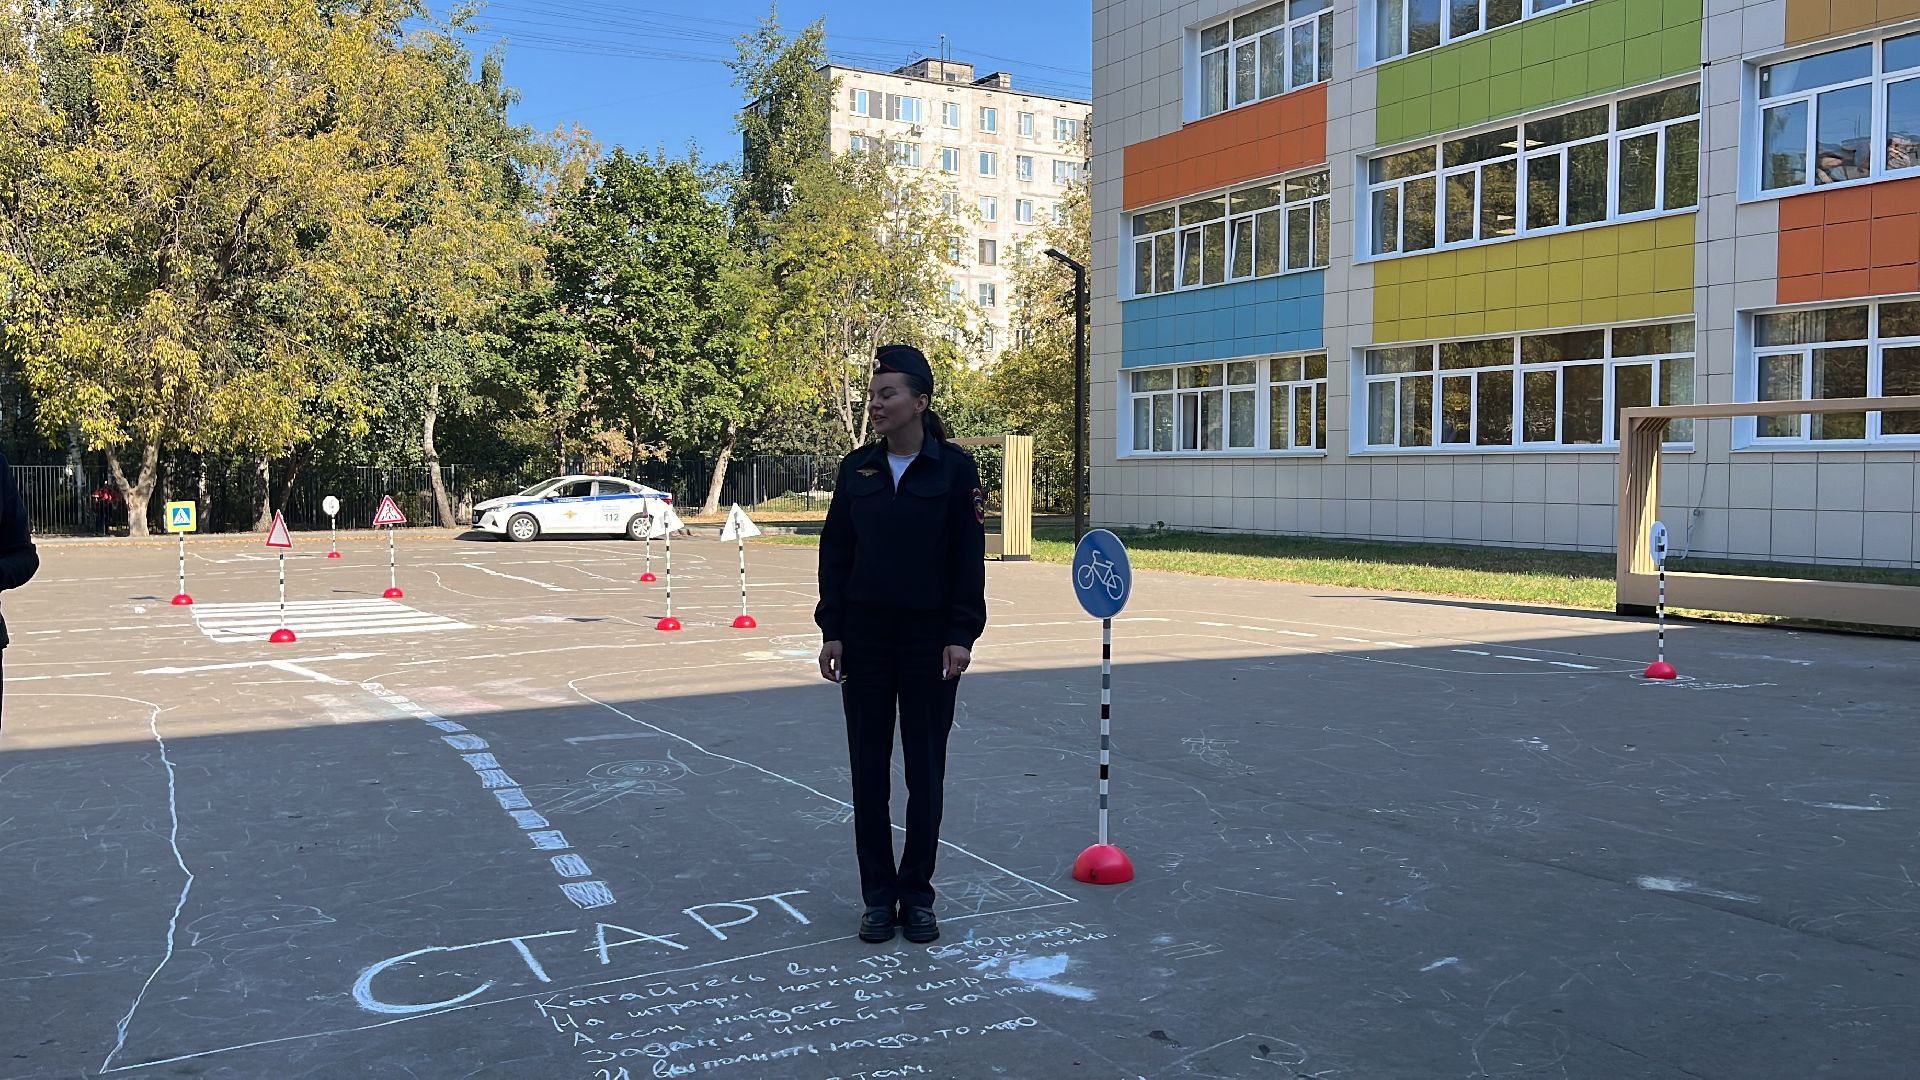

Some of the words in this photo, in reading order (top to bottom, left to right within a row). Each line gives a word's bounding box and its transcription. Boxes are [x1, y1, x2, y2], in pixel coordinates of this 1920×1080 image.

[603, 512, 621, 522] 112
[350, 889, 811, 1014] СТАРТ
[533, 973, 766, 1017] Катайтесь
[786, 962, 838, 976] вы
[551, 1013, 605, 1033] На
[774, 1003, 929, 1035] читайте
[573, 1031, 596, 1047] А
[607, 1024, 687, 1041] если
